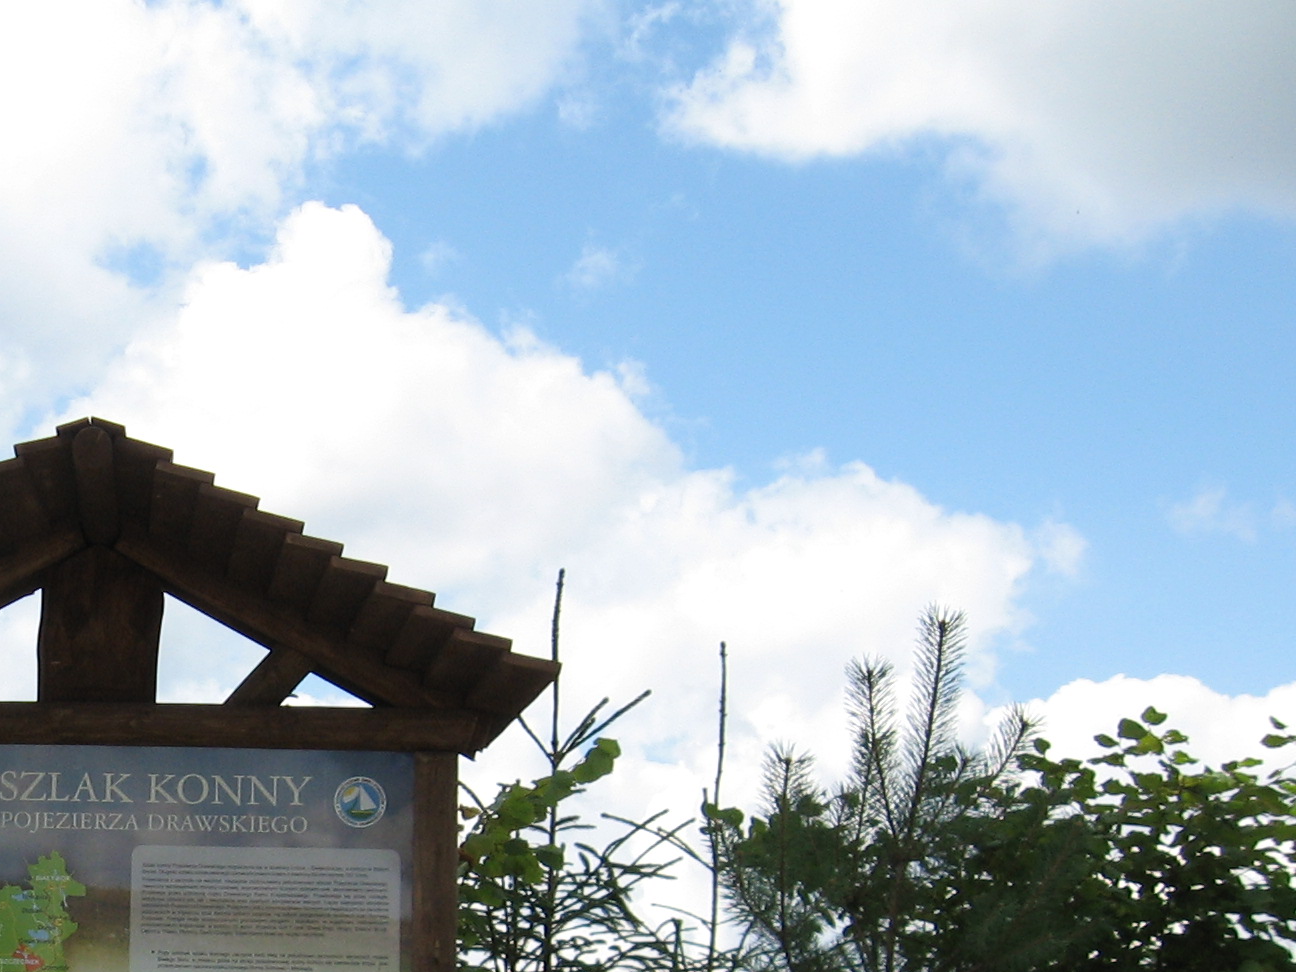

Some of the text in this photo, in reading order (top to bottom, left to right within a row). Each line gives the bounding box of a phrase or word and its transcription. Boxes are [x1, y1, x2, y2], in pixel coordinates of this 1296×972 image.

[146, 773, 313, 807] KONNY
[0, 810, 309, 834] POJEZIERZA DRAWSKIEGO
